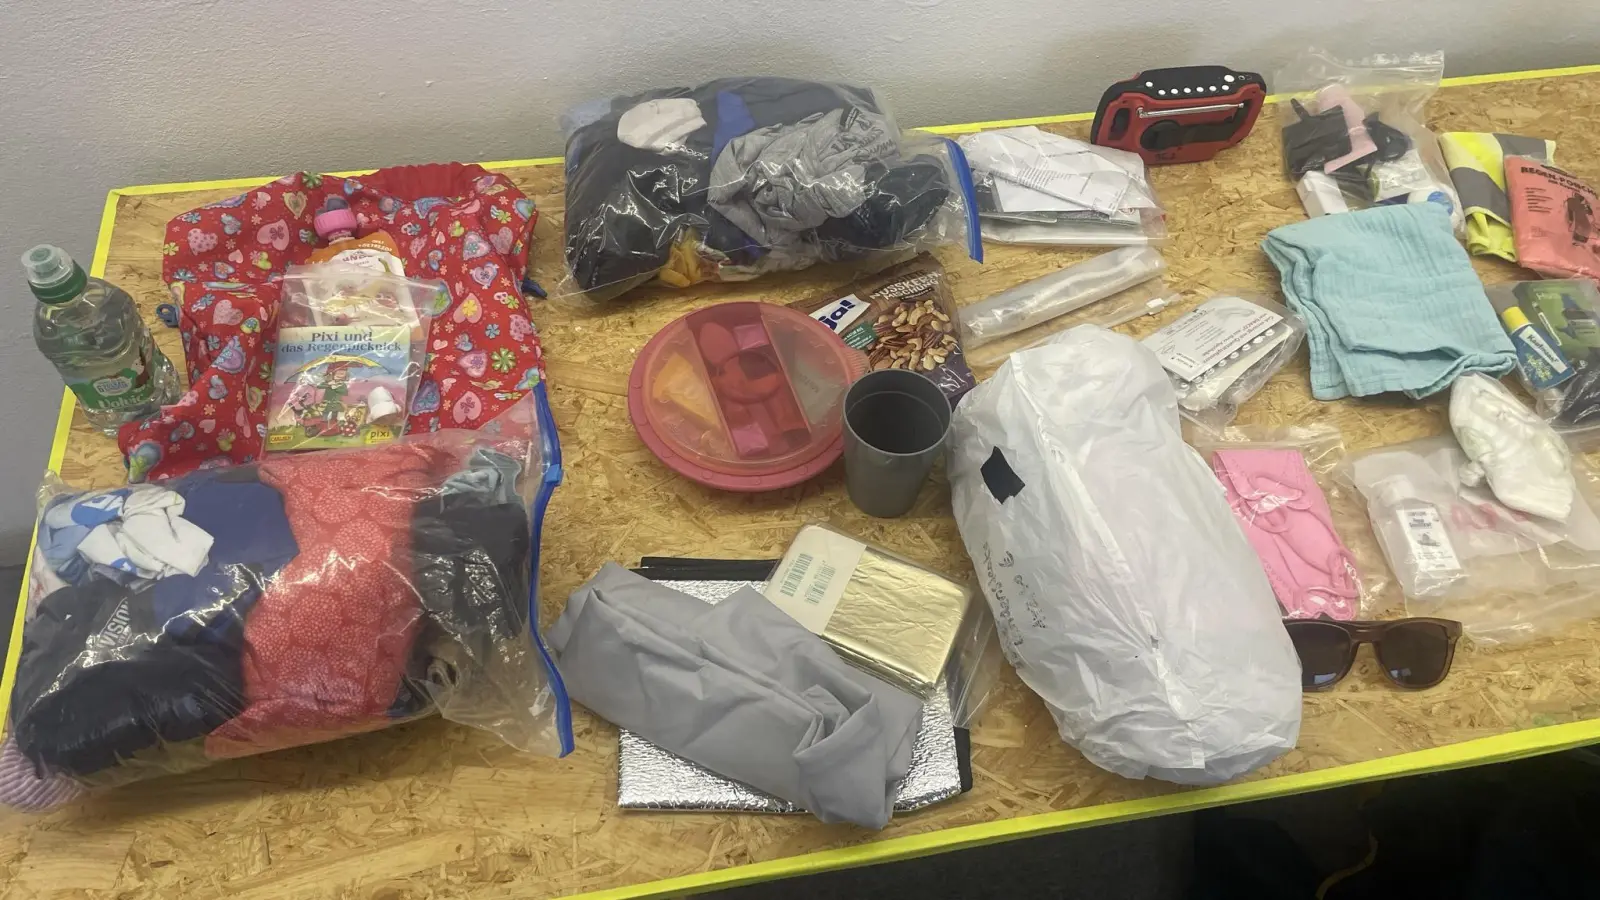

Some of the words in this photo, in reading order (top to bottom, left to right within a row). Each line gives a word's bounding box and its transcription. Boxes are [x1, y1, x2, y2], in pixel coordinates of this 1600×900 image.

[883, 278, 939, 300] MISCHUNG
[311, 331, 339, 342] Pixi
[344, 331, 373, 342] und
[281, 343, 304, 353] das
[370, 430, 390, 439] pixi
